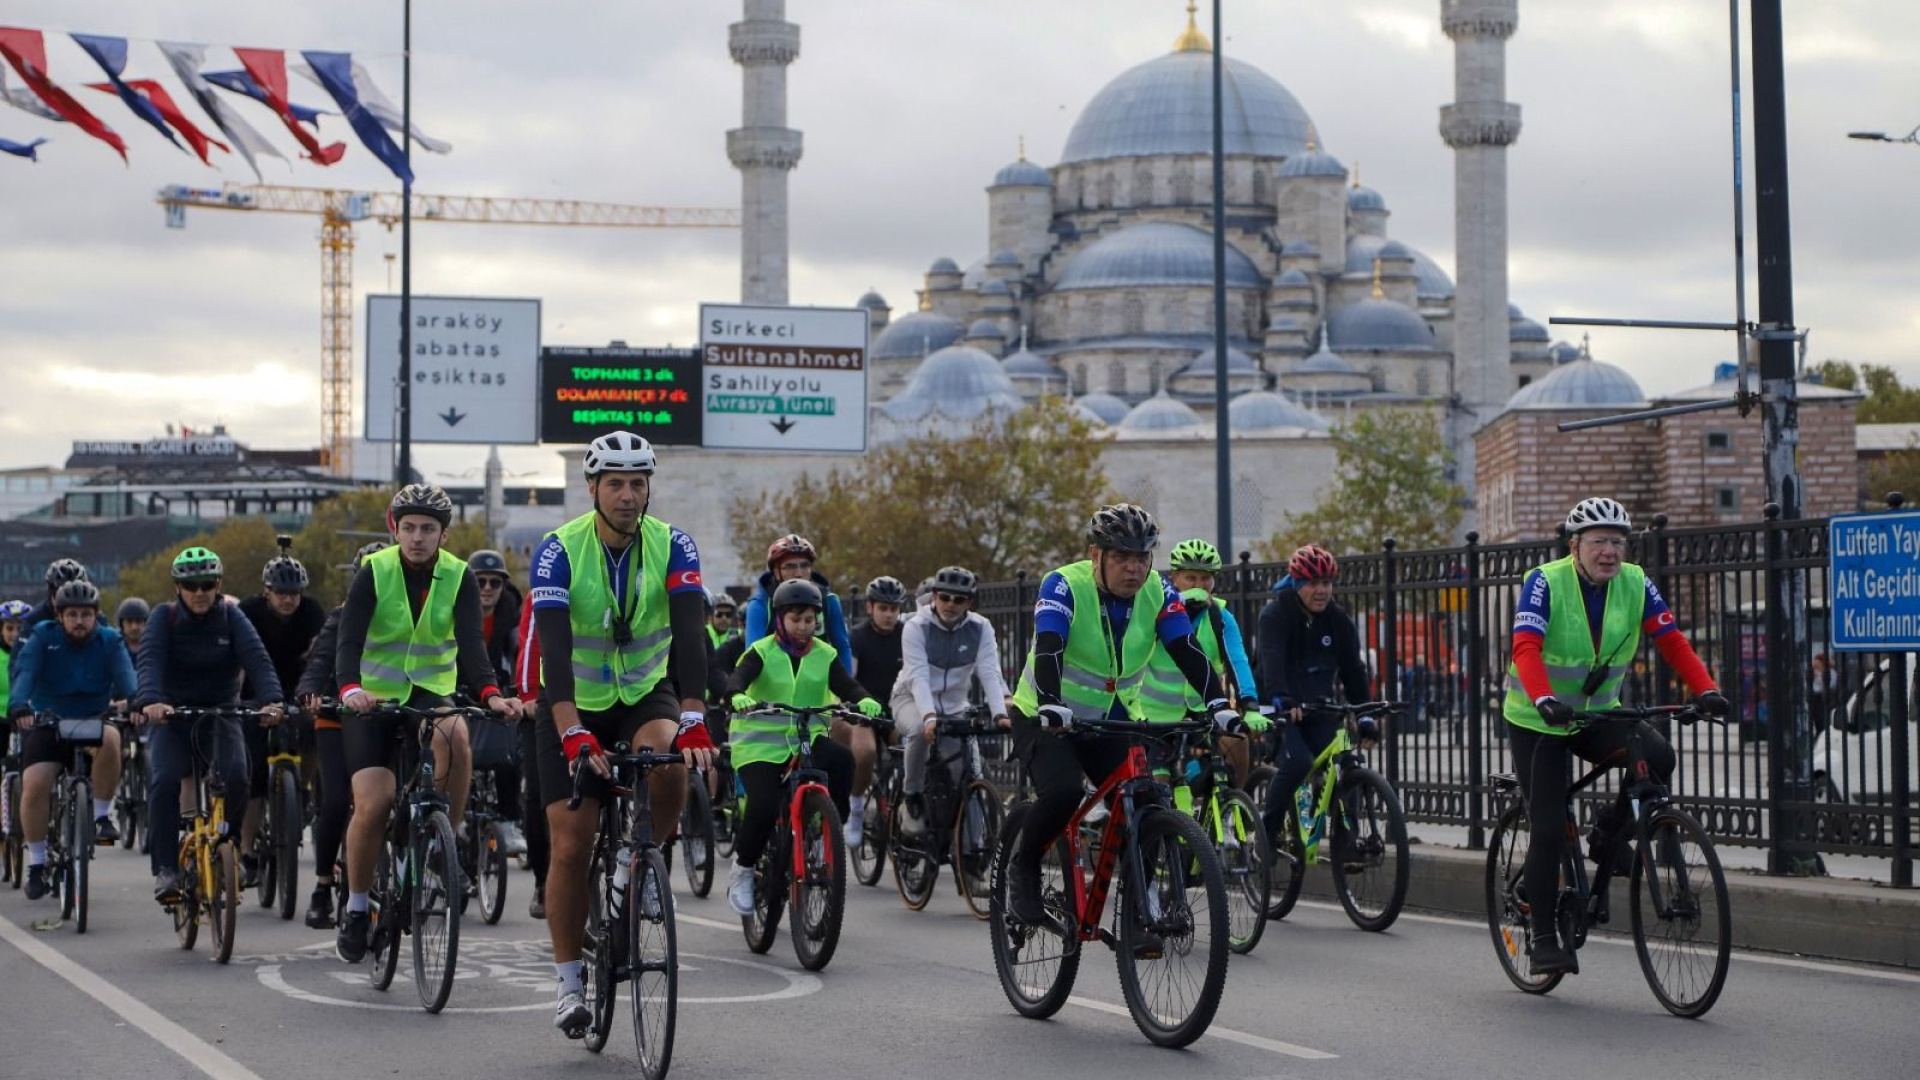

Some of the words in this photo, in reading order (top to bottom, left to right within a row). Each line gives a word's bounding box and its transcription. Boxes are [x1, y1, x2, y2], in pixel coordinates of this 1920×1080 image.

[399, 311, 503, 333] araköy
[711, 319, 796, 337] Sirkeci
[399, 339, 500, 358] abataş
[706, 346, 861, 367] Sultanahmet
[399, 367, 506, 386] eşiktaş
[571, 367, 641, 381] TOPHANE
[644, 368, 653, 381] 3
[654, 368, 674, 382] dk
[710, 374, 821, 394] Sahilyolu
[658, 388, 668, 401] 7
[669, 388, 688, 402] dk
[707, 395, 777, 413] Avrasya
[572, 408, 634, 425] BEŞİKTAŞ
[637, 410, 653, 424] 10
[655, 411, 673, 425] dk
[1835, 526, 1889, 557] Lütfen
[537, 540, 563, 579] BKBS
[1836, 570, 1859, 599] Alt
[1864, 567, 1920, 605] Geçidi
